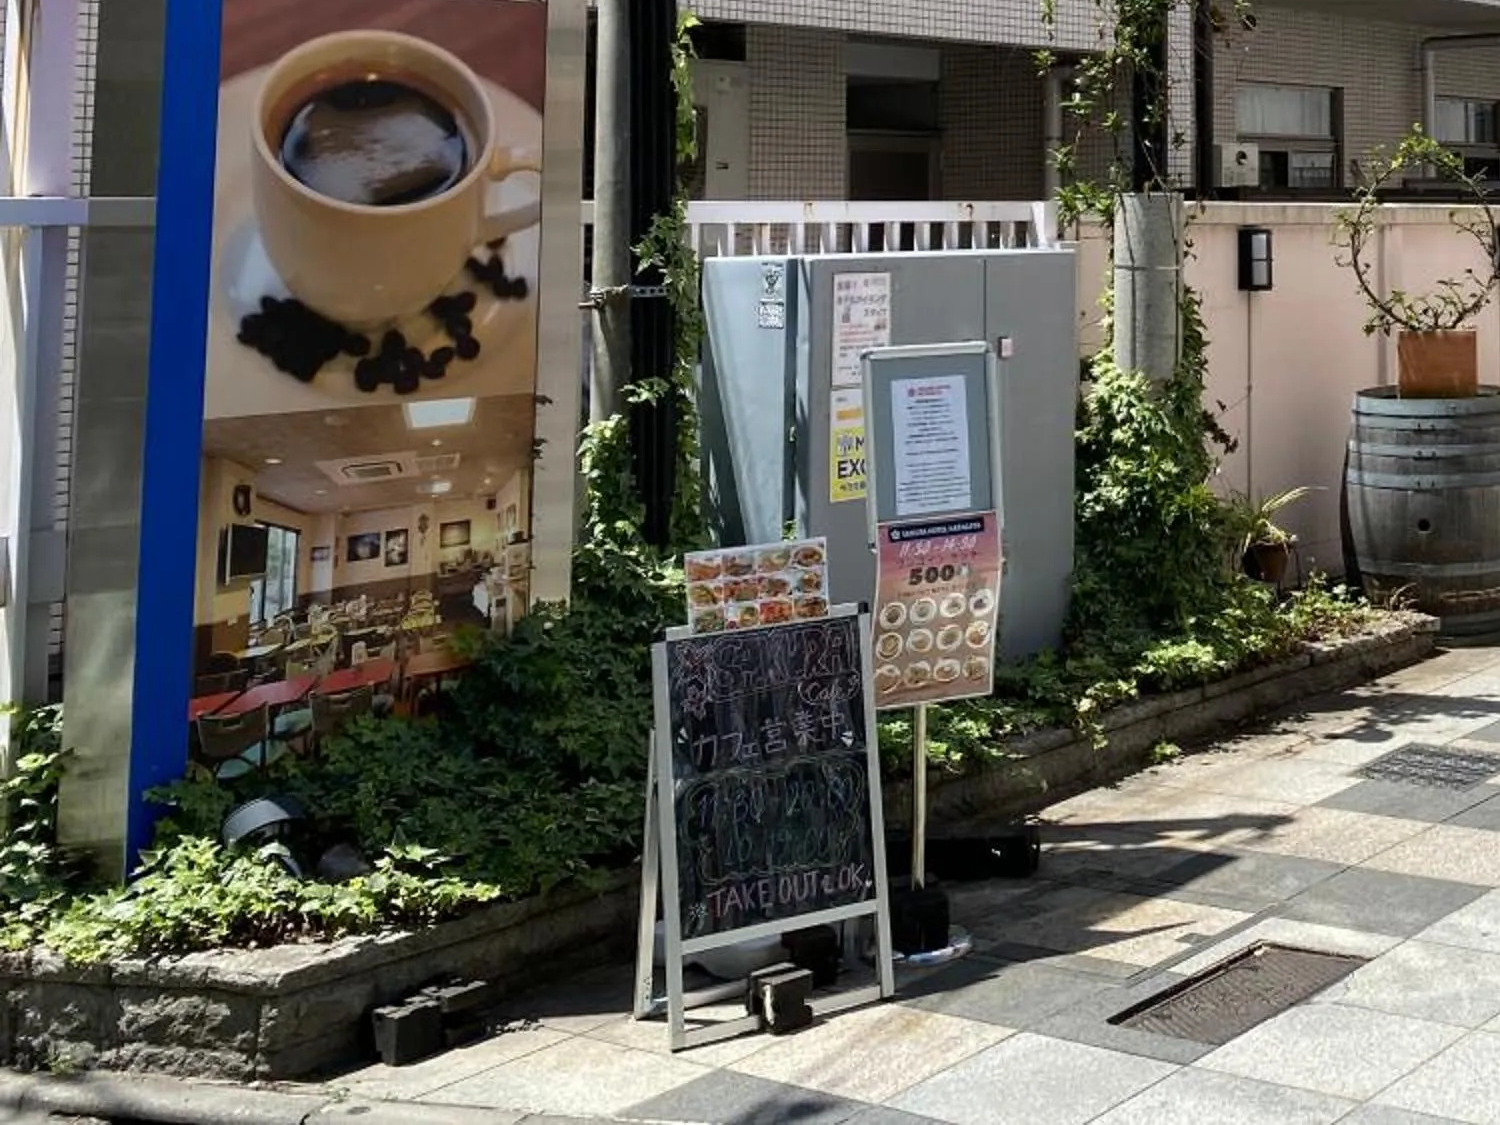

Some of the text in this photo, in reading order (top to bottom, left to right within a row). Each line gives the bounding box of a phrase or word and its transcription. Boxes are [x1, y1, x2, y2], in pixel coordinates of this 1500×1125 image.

[694, 710, 846, 765] カフェ営業中
[707, 878, 773, 919] TAKE
[779, 870, 818, 903] OUT
